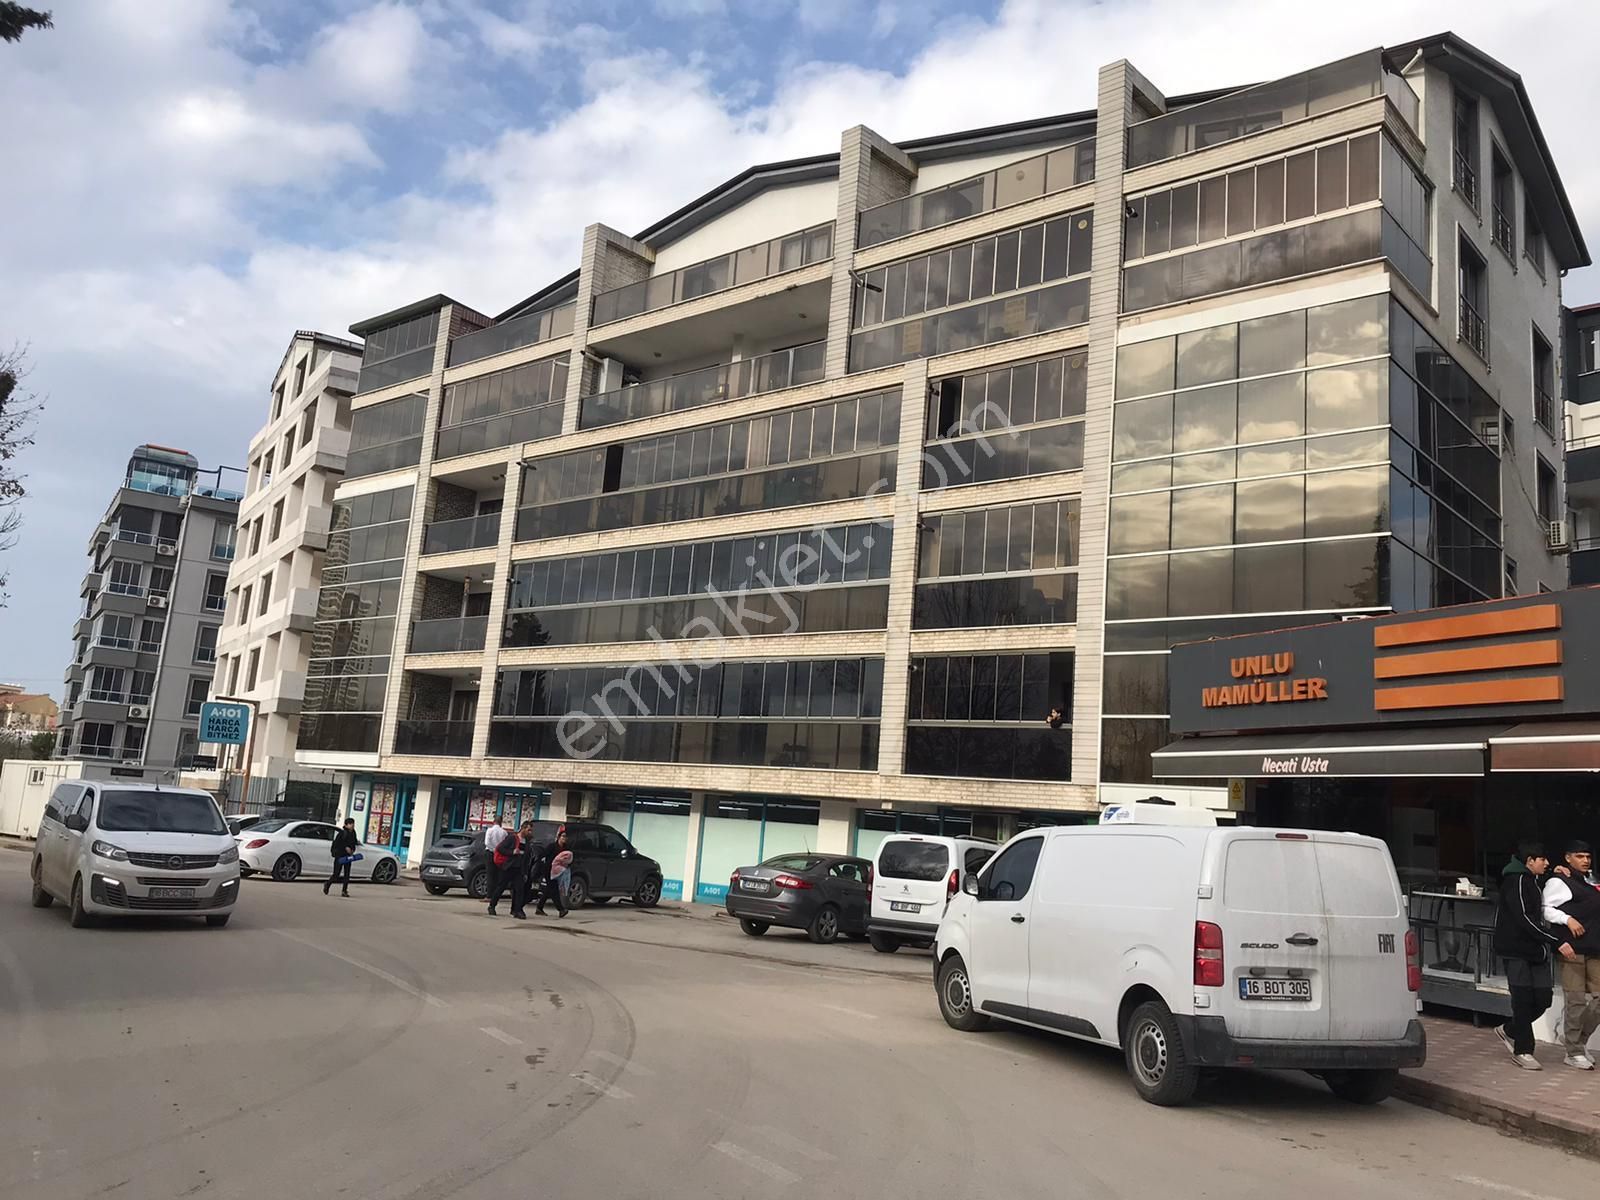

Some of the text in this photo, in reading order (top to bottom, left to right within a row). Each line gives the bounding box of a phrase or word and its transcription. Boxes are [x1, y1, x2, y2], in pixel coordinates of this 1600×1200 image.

[1230, 652, 1294, 677] UNLU
[1201, 676, 1328, 708] MAMÜLLER
[207, 725, 240, 733] HARCA
[208, 718, 241, 727] HARCA
[1261, 756, 1329, 773] Necati Usta
[1377, 934, 1396, 954] FIAT
[1247, 981, 1309, 996] 16 BOT 305
